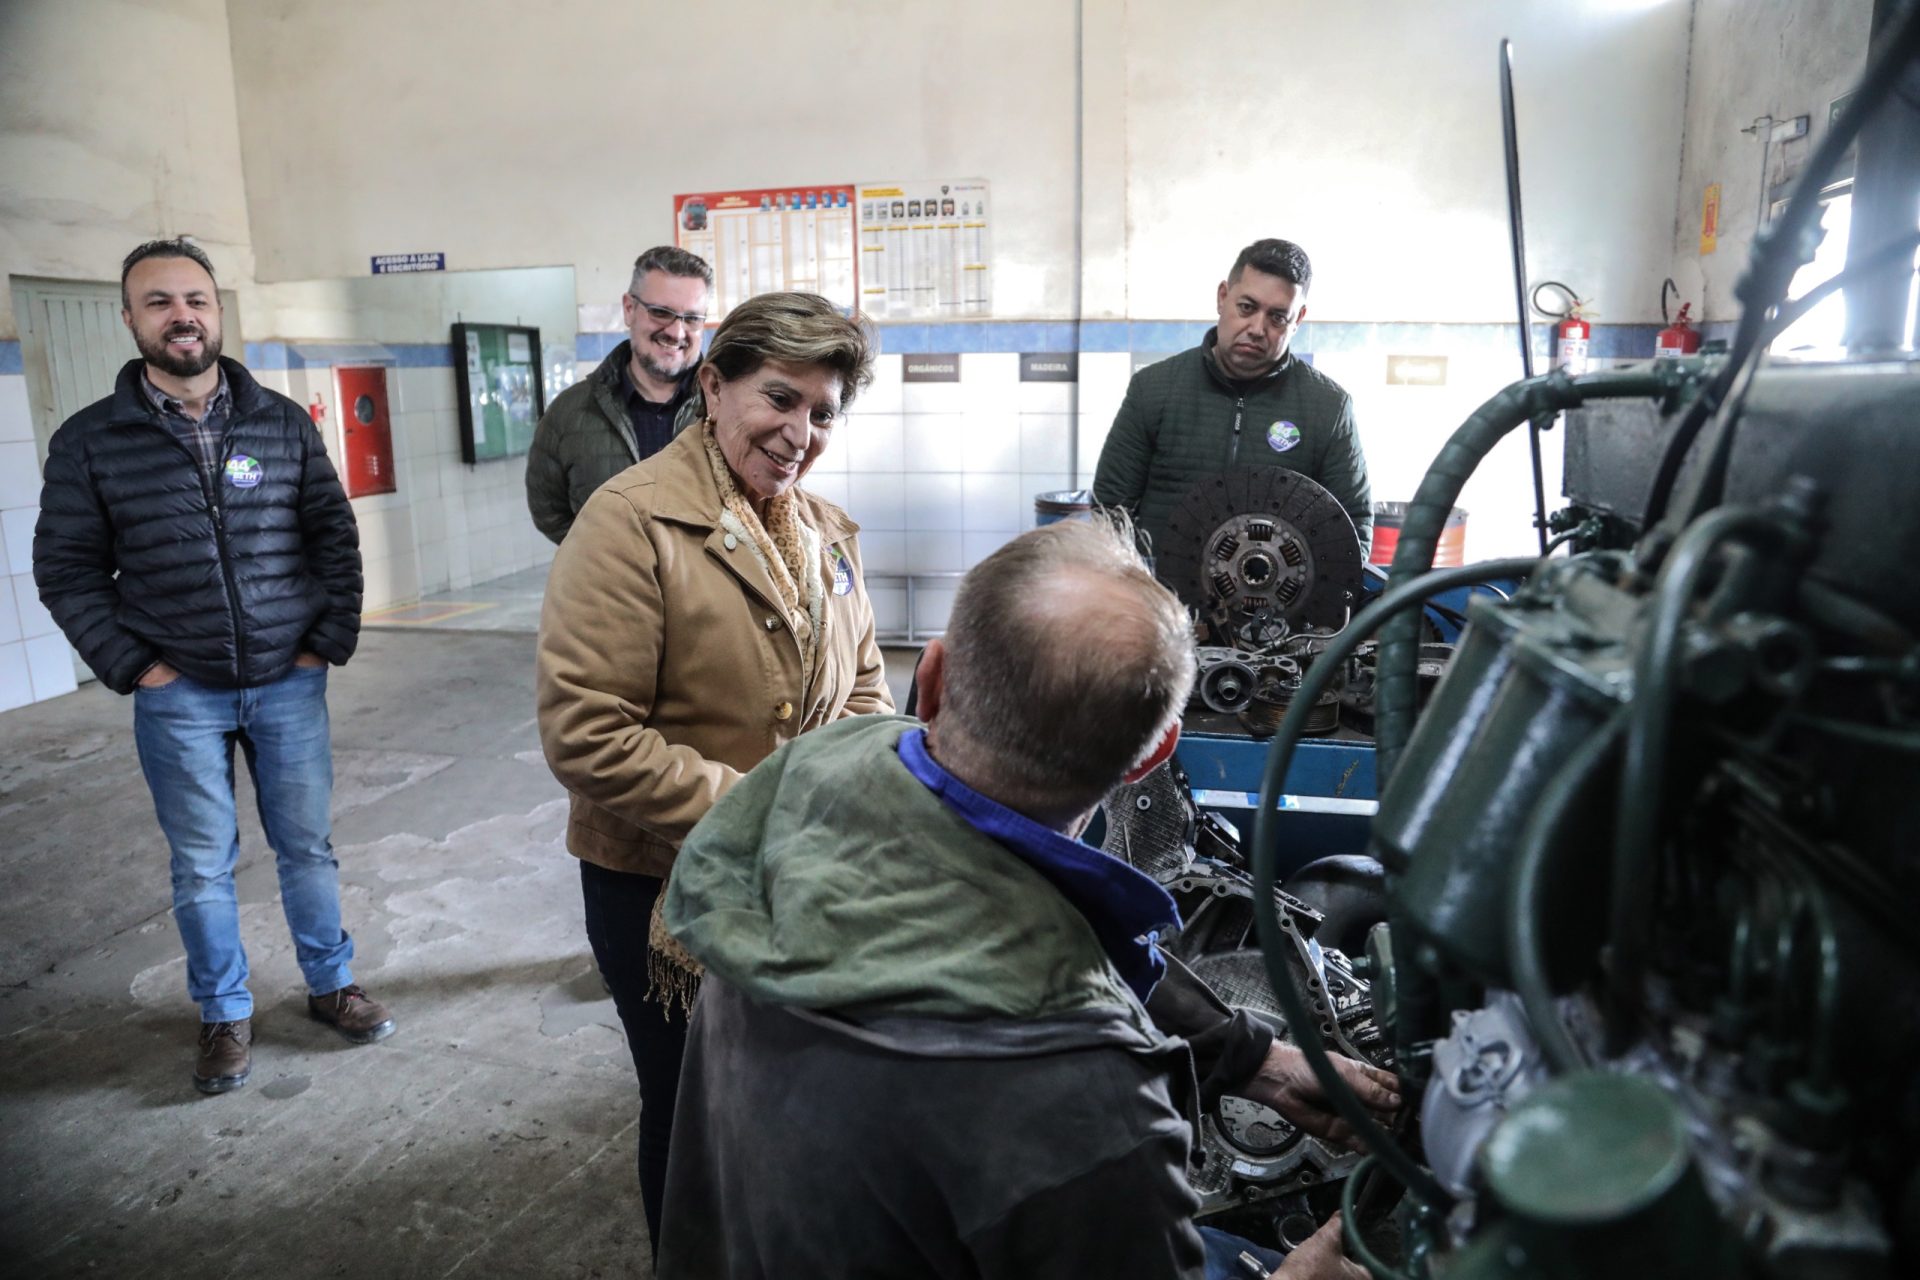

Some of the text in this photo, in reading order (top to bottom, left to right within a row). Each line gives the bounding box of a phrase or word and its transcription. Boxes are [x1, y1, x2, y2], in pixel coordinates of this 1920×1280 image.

[375, 255, 408, 265] ACESSO
[418, 253, 439, 262] LOJA
[908, 363, 954, 373] ORGÂNICOS
[1030, 363, 1068, 371] MADEIRA
[227, 459, 249, 472] 44
[232, 471, 257, 481] BETH
